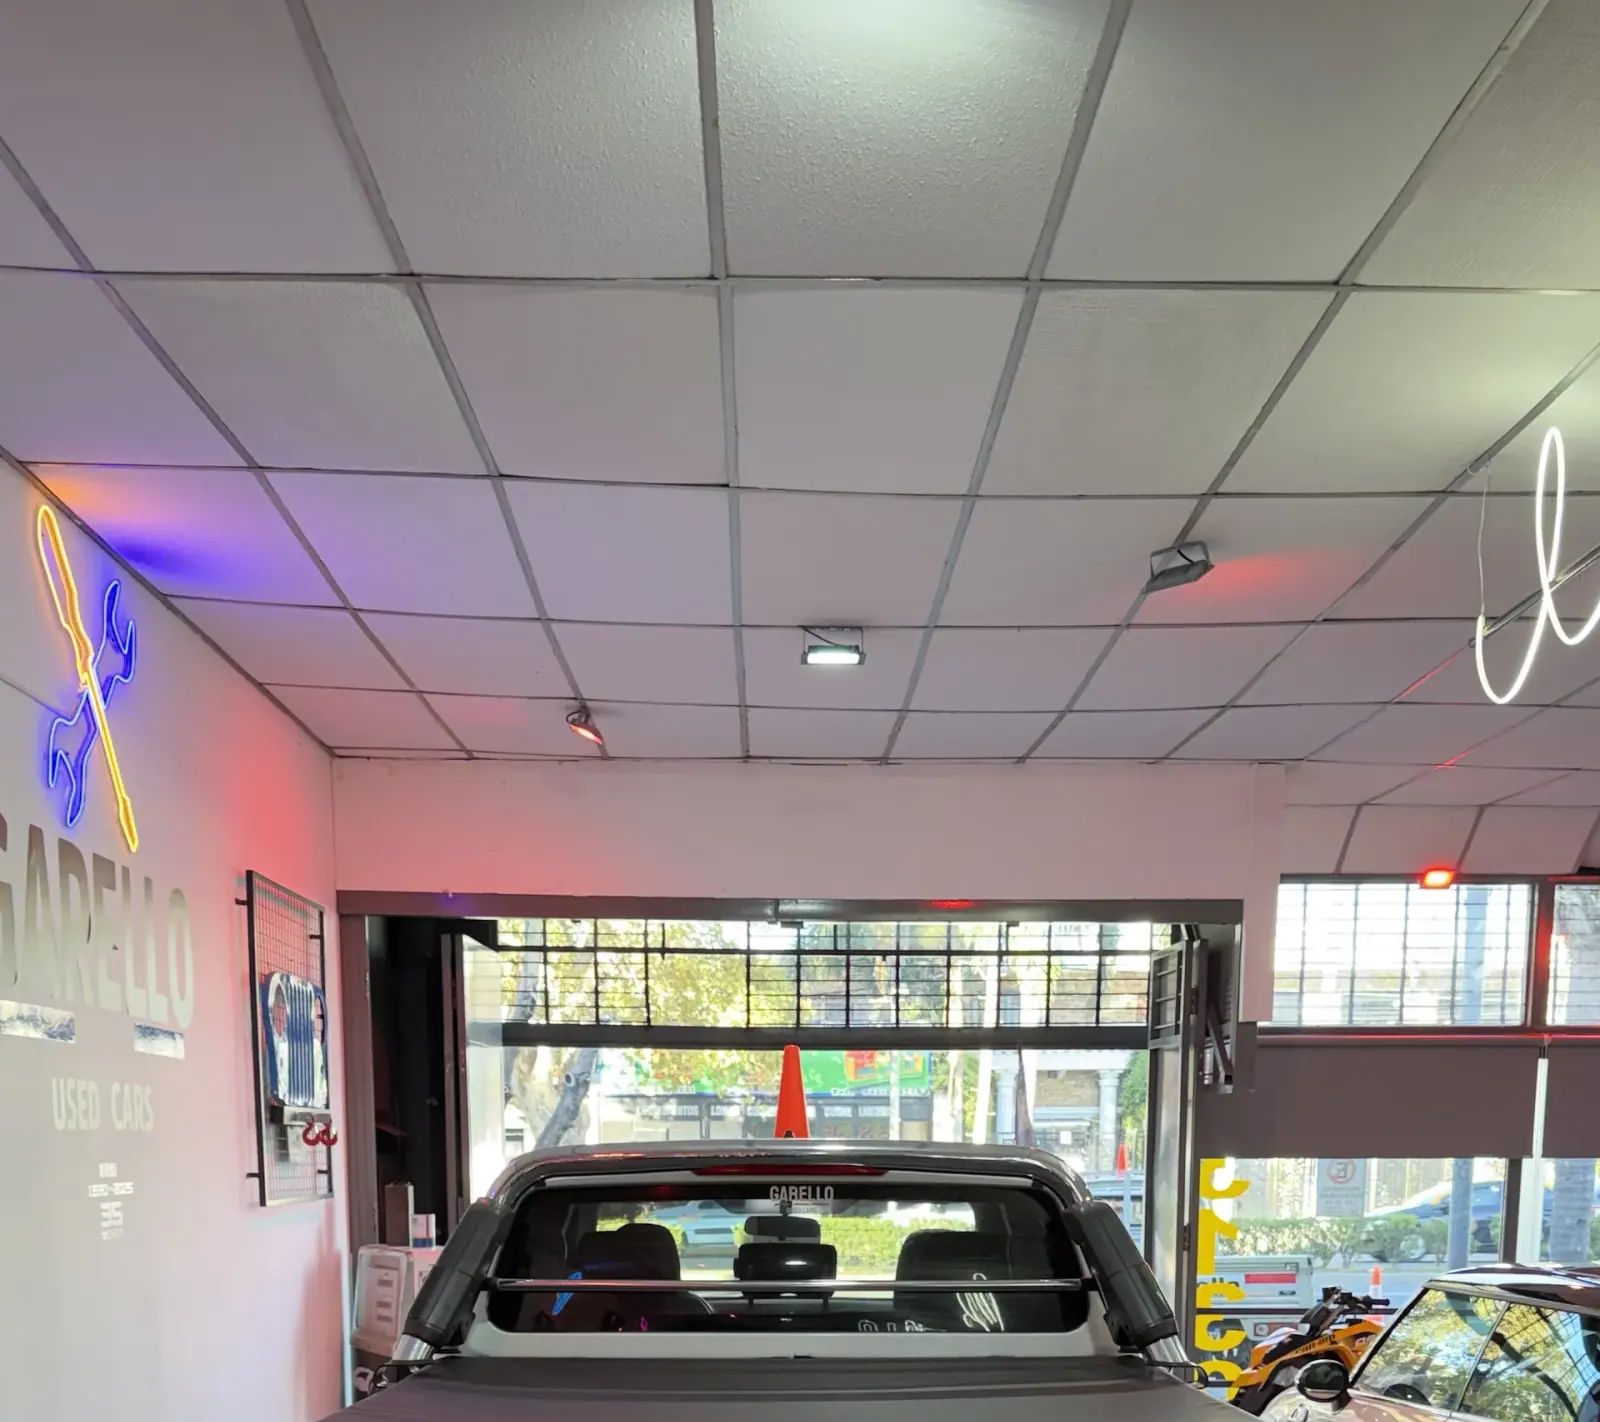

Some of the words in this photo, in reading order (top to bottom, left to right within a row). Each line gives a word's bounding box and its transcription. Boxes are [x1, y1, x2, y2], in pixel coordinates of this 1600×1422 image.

[52, 1077, 100, 1130] USED
[111, 1081, 154, 1132] CARS
[769, 1185, 834, 1201] GARELLO
